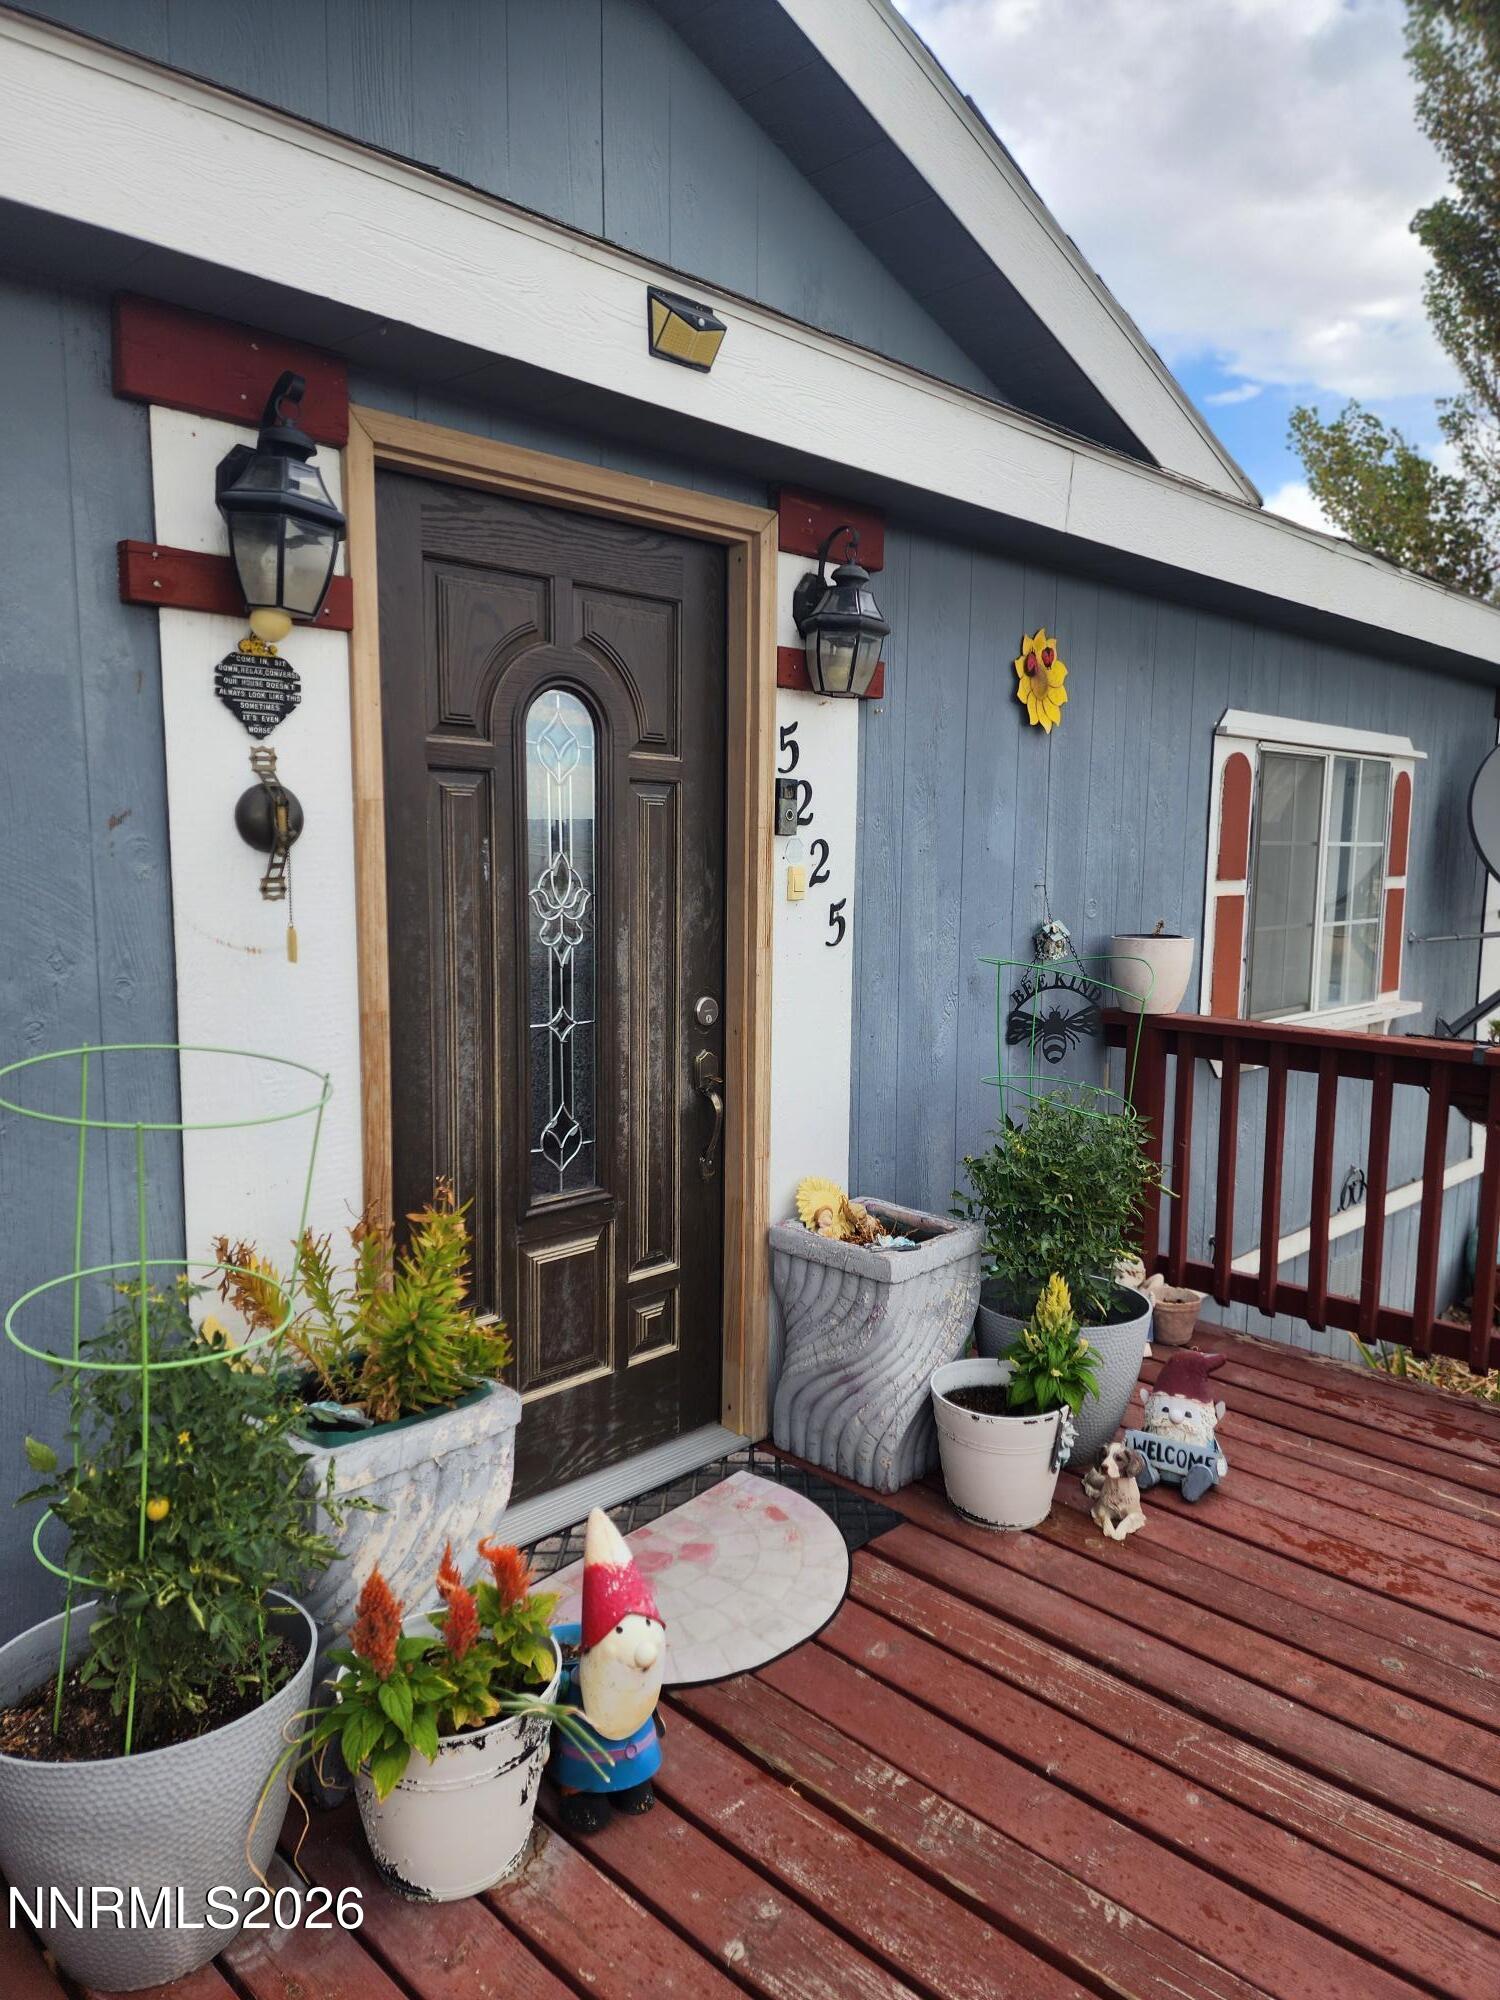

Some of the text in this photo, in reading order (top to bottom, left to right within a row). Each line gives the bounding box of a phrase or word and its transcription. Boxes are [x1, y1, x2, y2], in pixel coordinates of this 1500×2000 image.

[241, 679, 264, 688] HOUSE
[265, 681, 295, 690] DOESN'T
[218, 688, 301, 703] ALWAYS LOOK LIKE THIS
[239, 702, 281, 712] SOMETIMES
[1010, 971, 1103, 1006] BEE KIND
[1133, 1437, 1215, 1471] WELCOME
